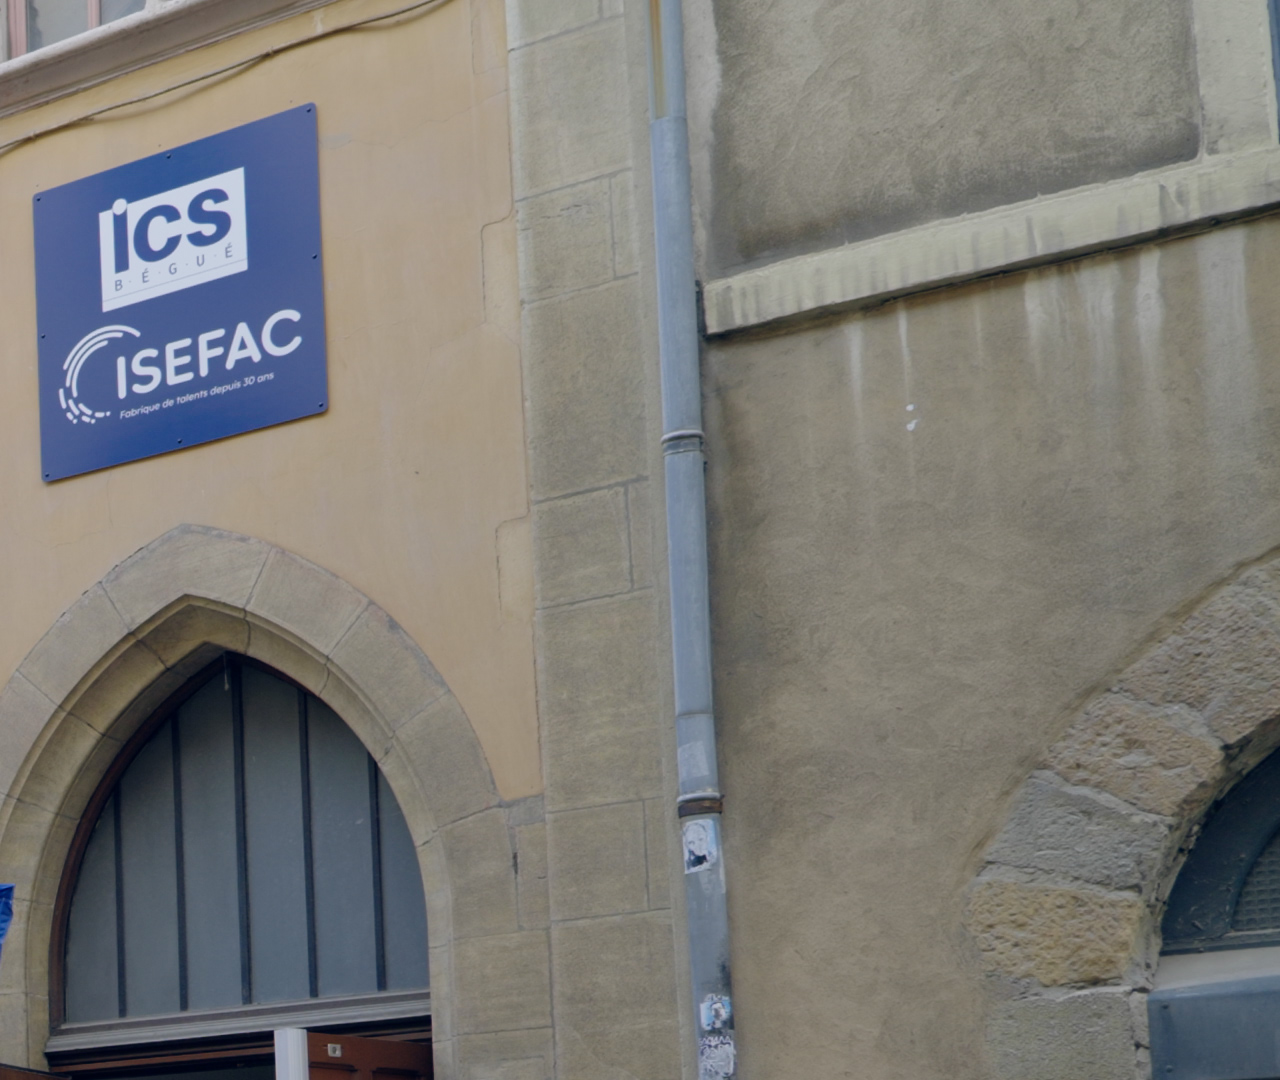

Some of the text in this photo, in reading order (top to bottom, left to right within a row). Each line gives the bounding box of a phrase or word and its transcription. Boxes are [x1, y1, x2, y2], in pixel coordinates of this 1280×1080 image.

[117, 309, 302, 399] ISEFAC
[119, 372, 274, 419] Fabrique de talents depuis 30 ans
